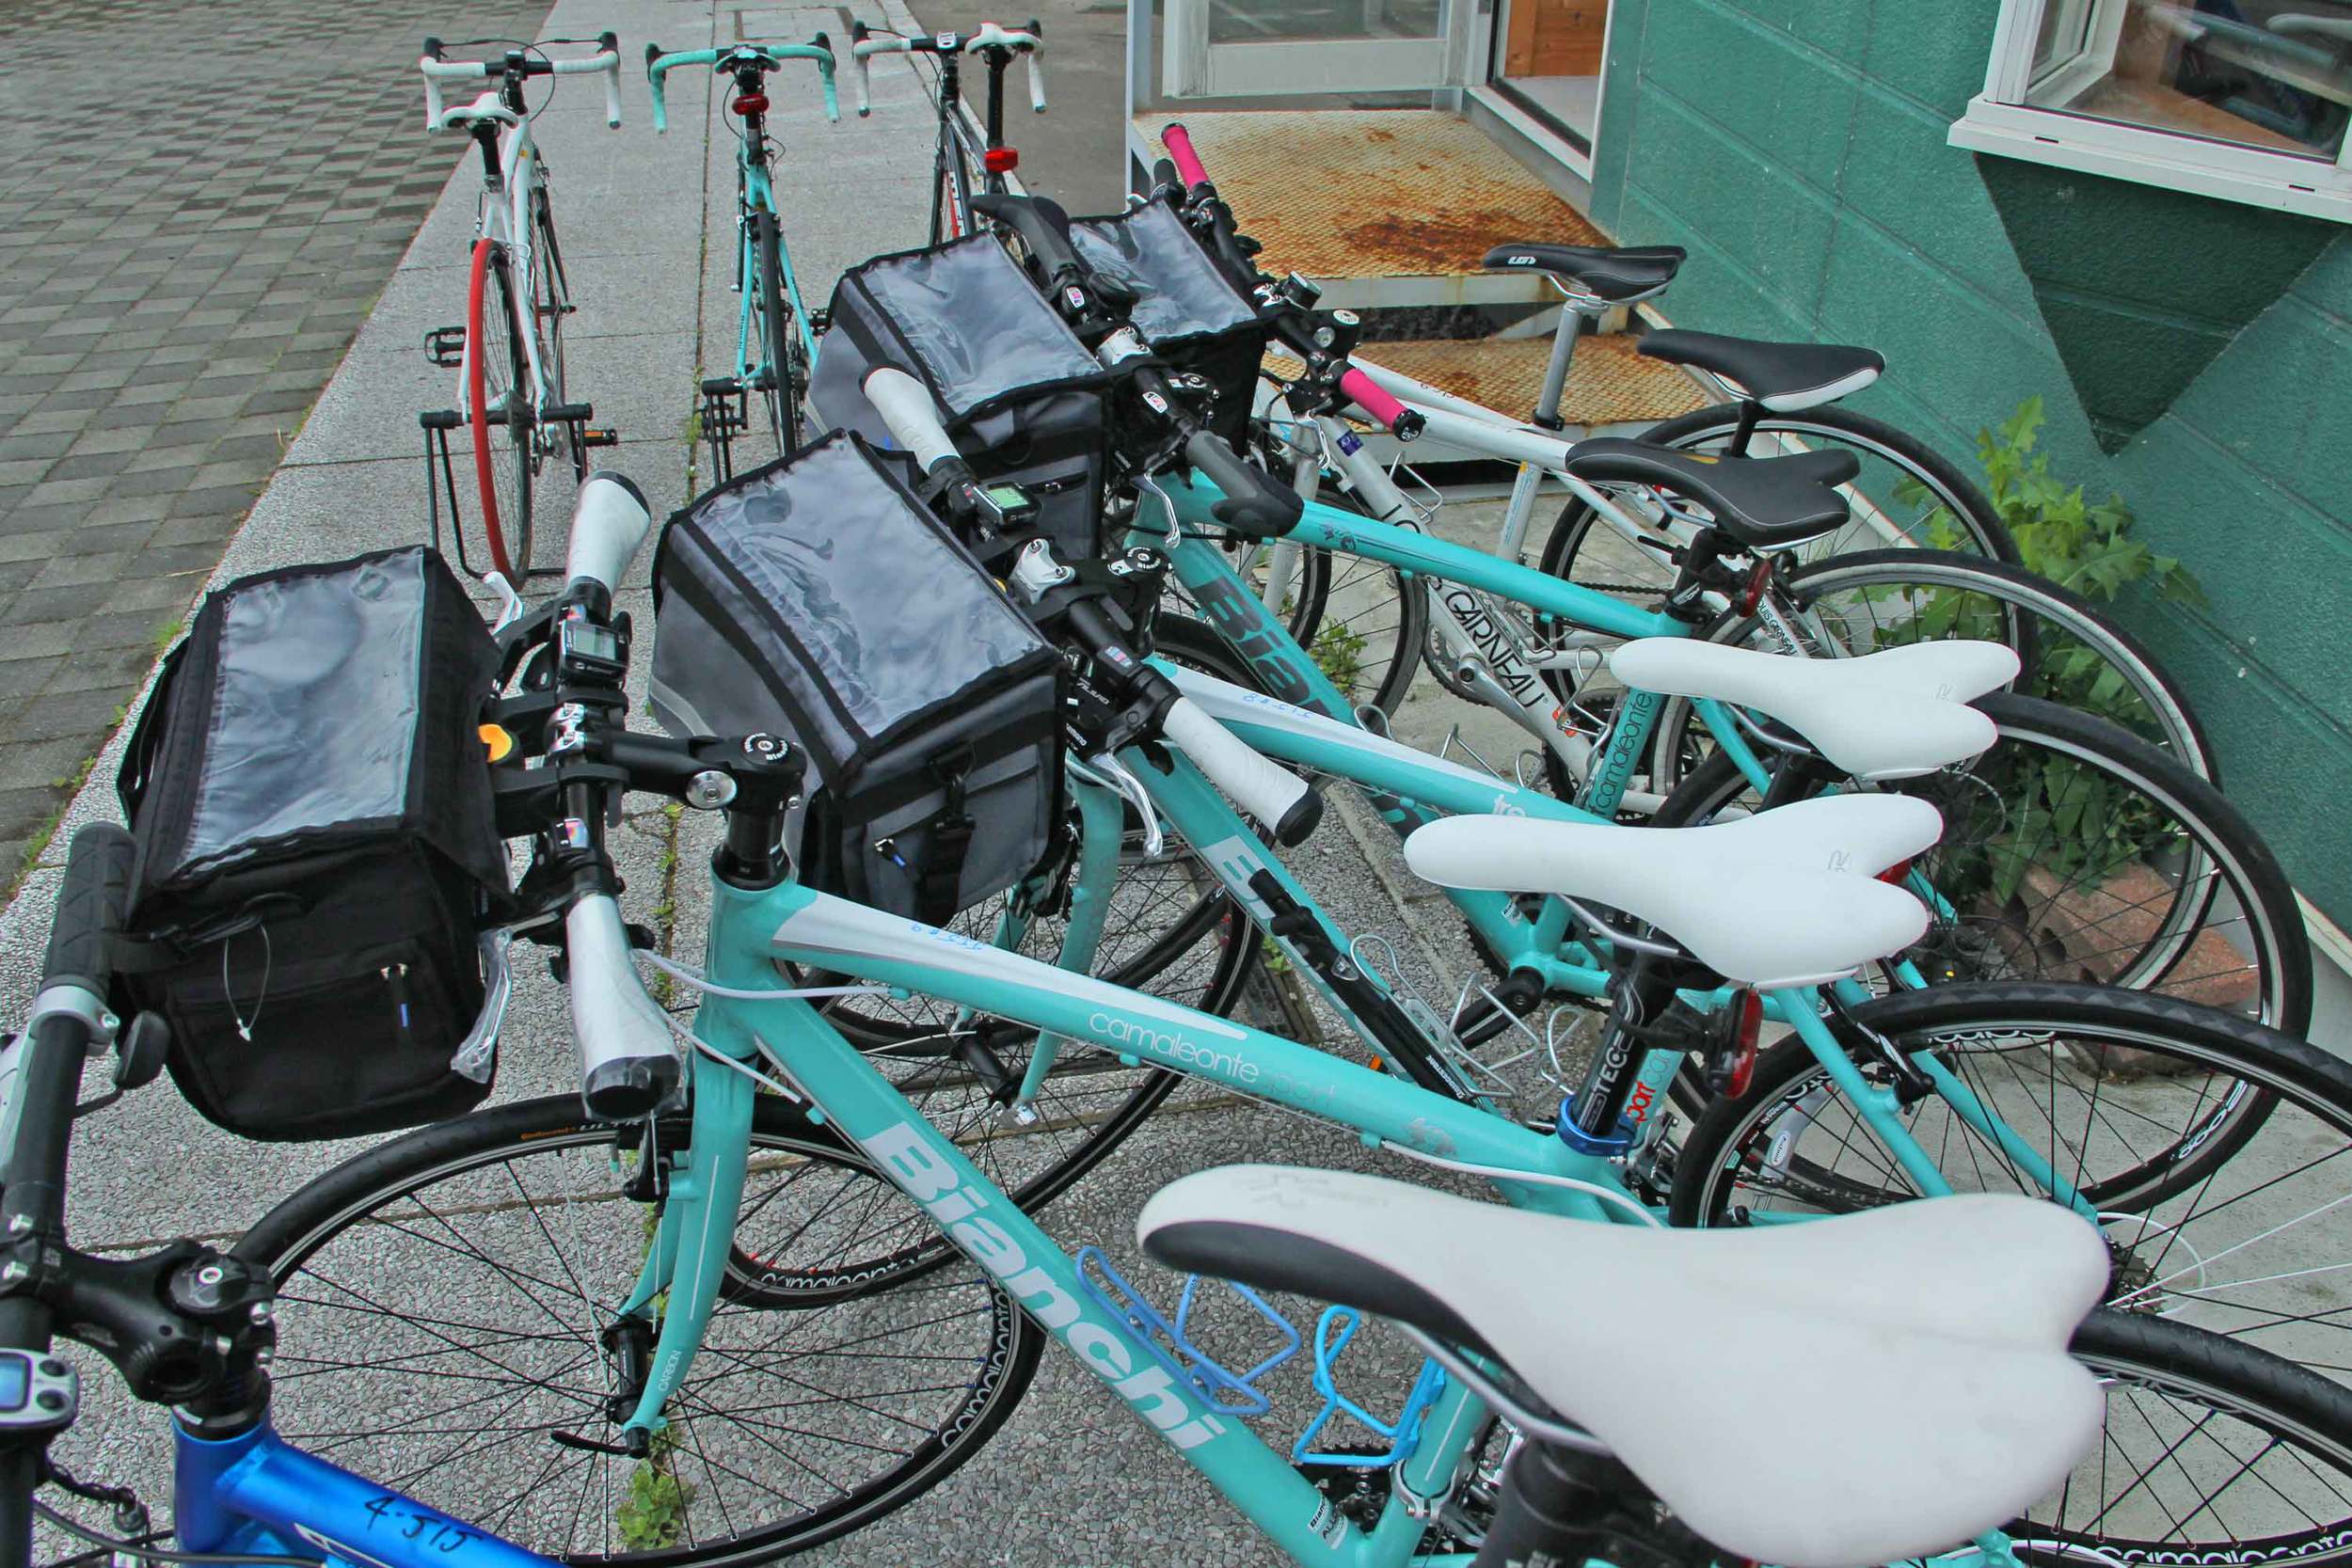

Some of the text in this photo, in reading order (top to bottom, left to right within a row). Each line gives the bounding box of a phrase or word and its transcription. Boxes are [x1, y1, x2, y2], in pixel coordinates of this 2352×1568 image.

[1445, 591, 1545, 708] GARNEAU
[1595, 692, 1652, 806] camaleonte
[1089, 1012, 1260, 1084] camaleonte
[862, 1122, 1226, 1449] Bianchi
